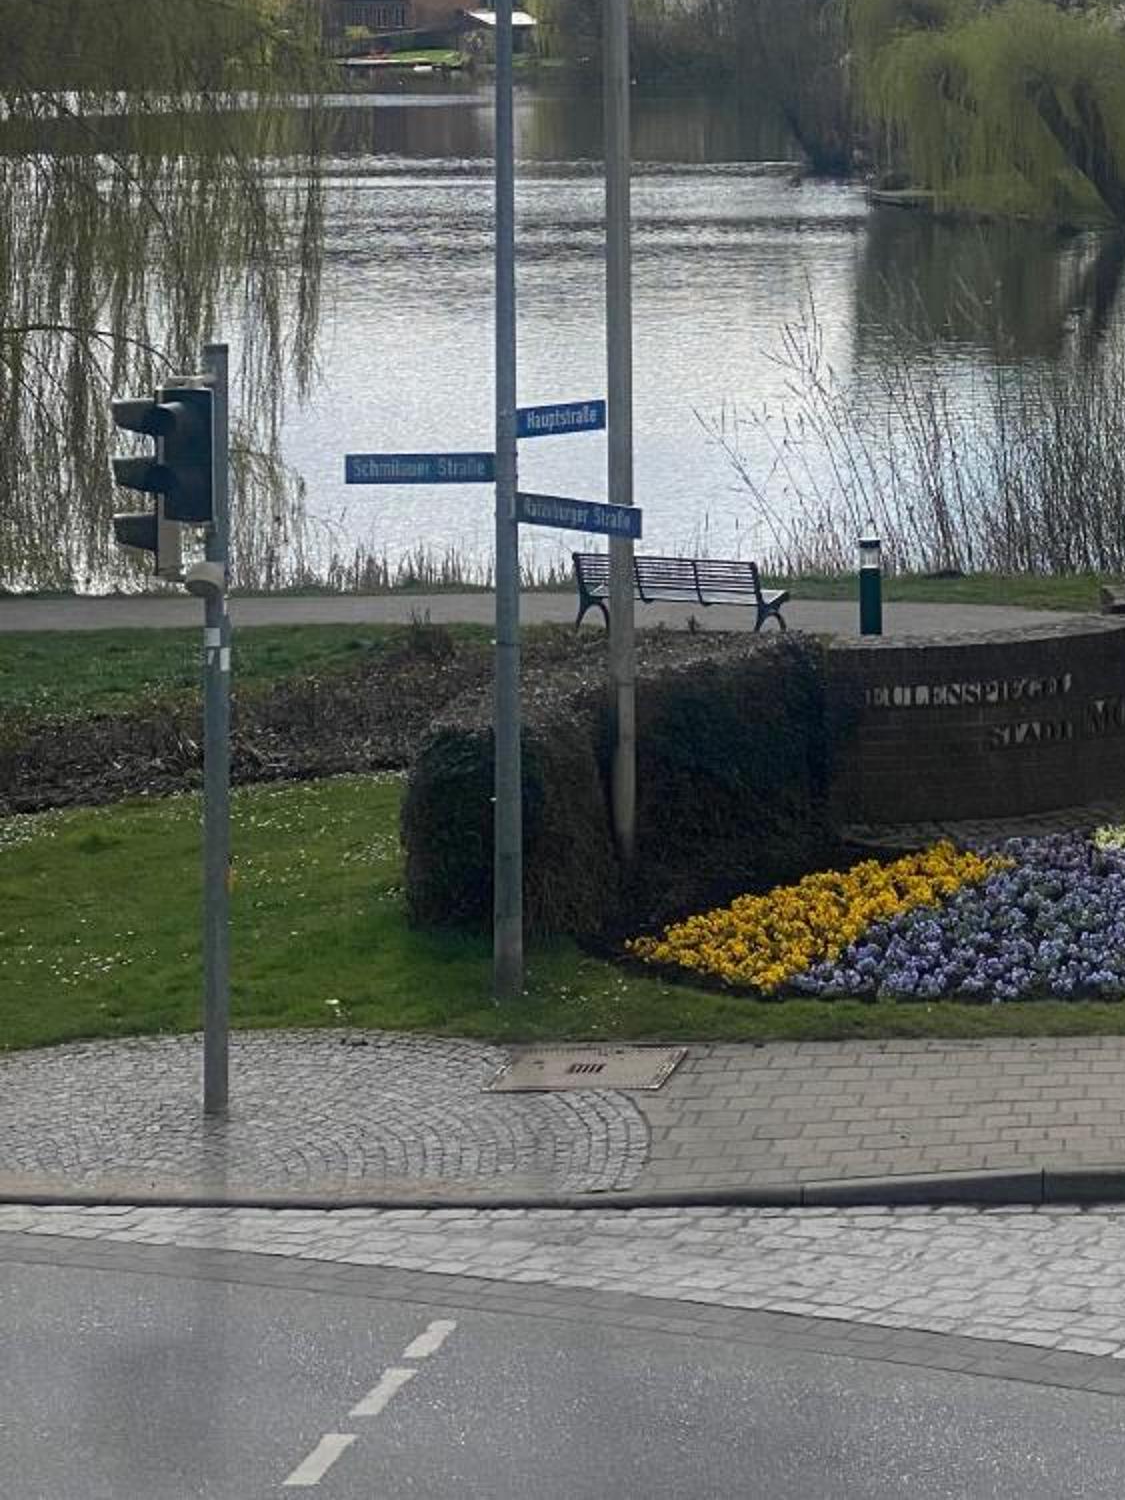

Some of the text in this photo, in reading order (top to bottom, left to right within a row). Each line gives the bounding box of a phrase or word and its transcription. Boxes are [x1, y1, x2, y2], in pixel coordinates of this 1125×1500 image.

[526, 405, 597, 430] Hauptstraße
[437, 457, 486, 477] Straße
[592, 507, 632, 530] Straße
